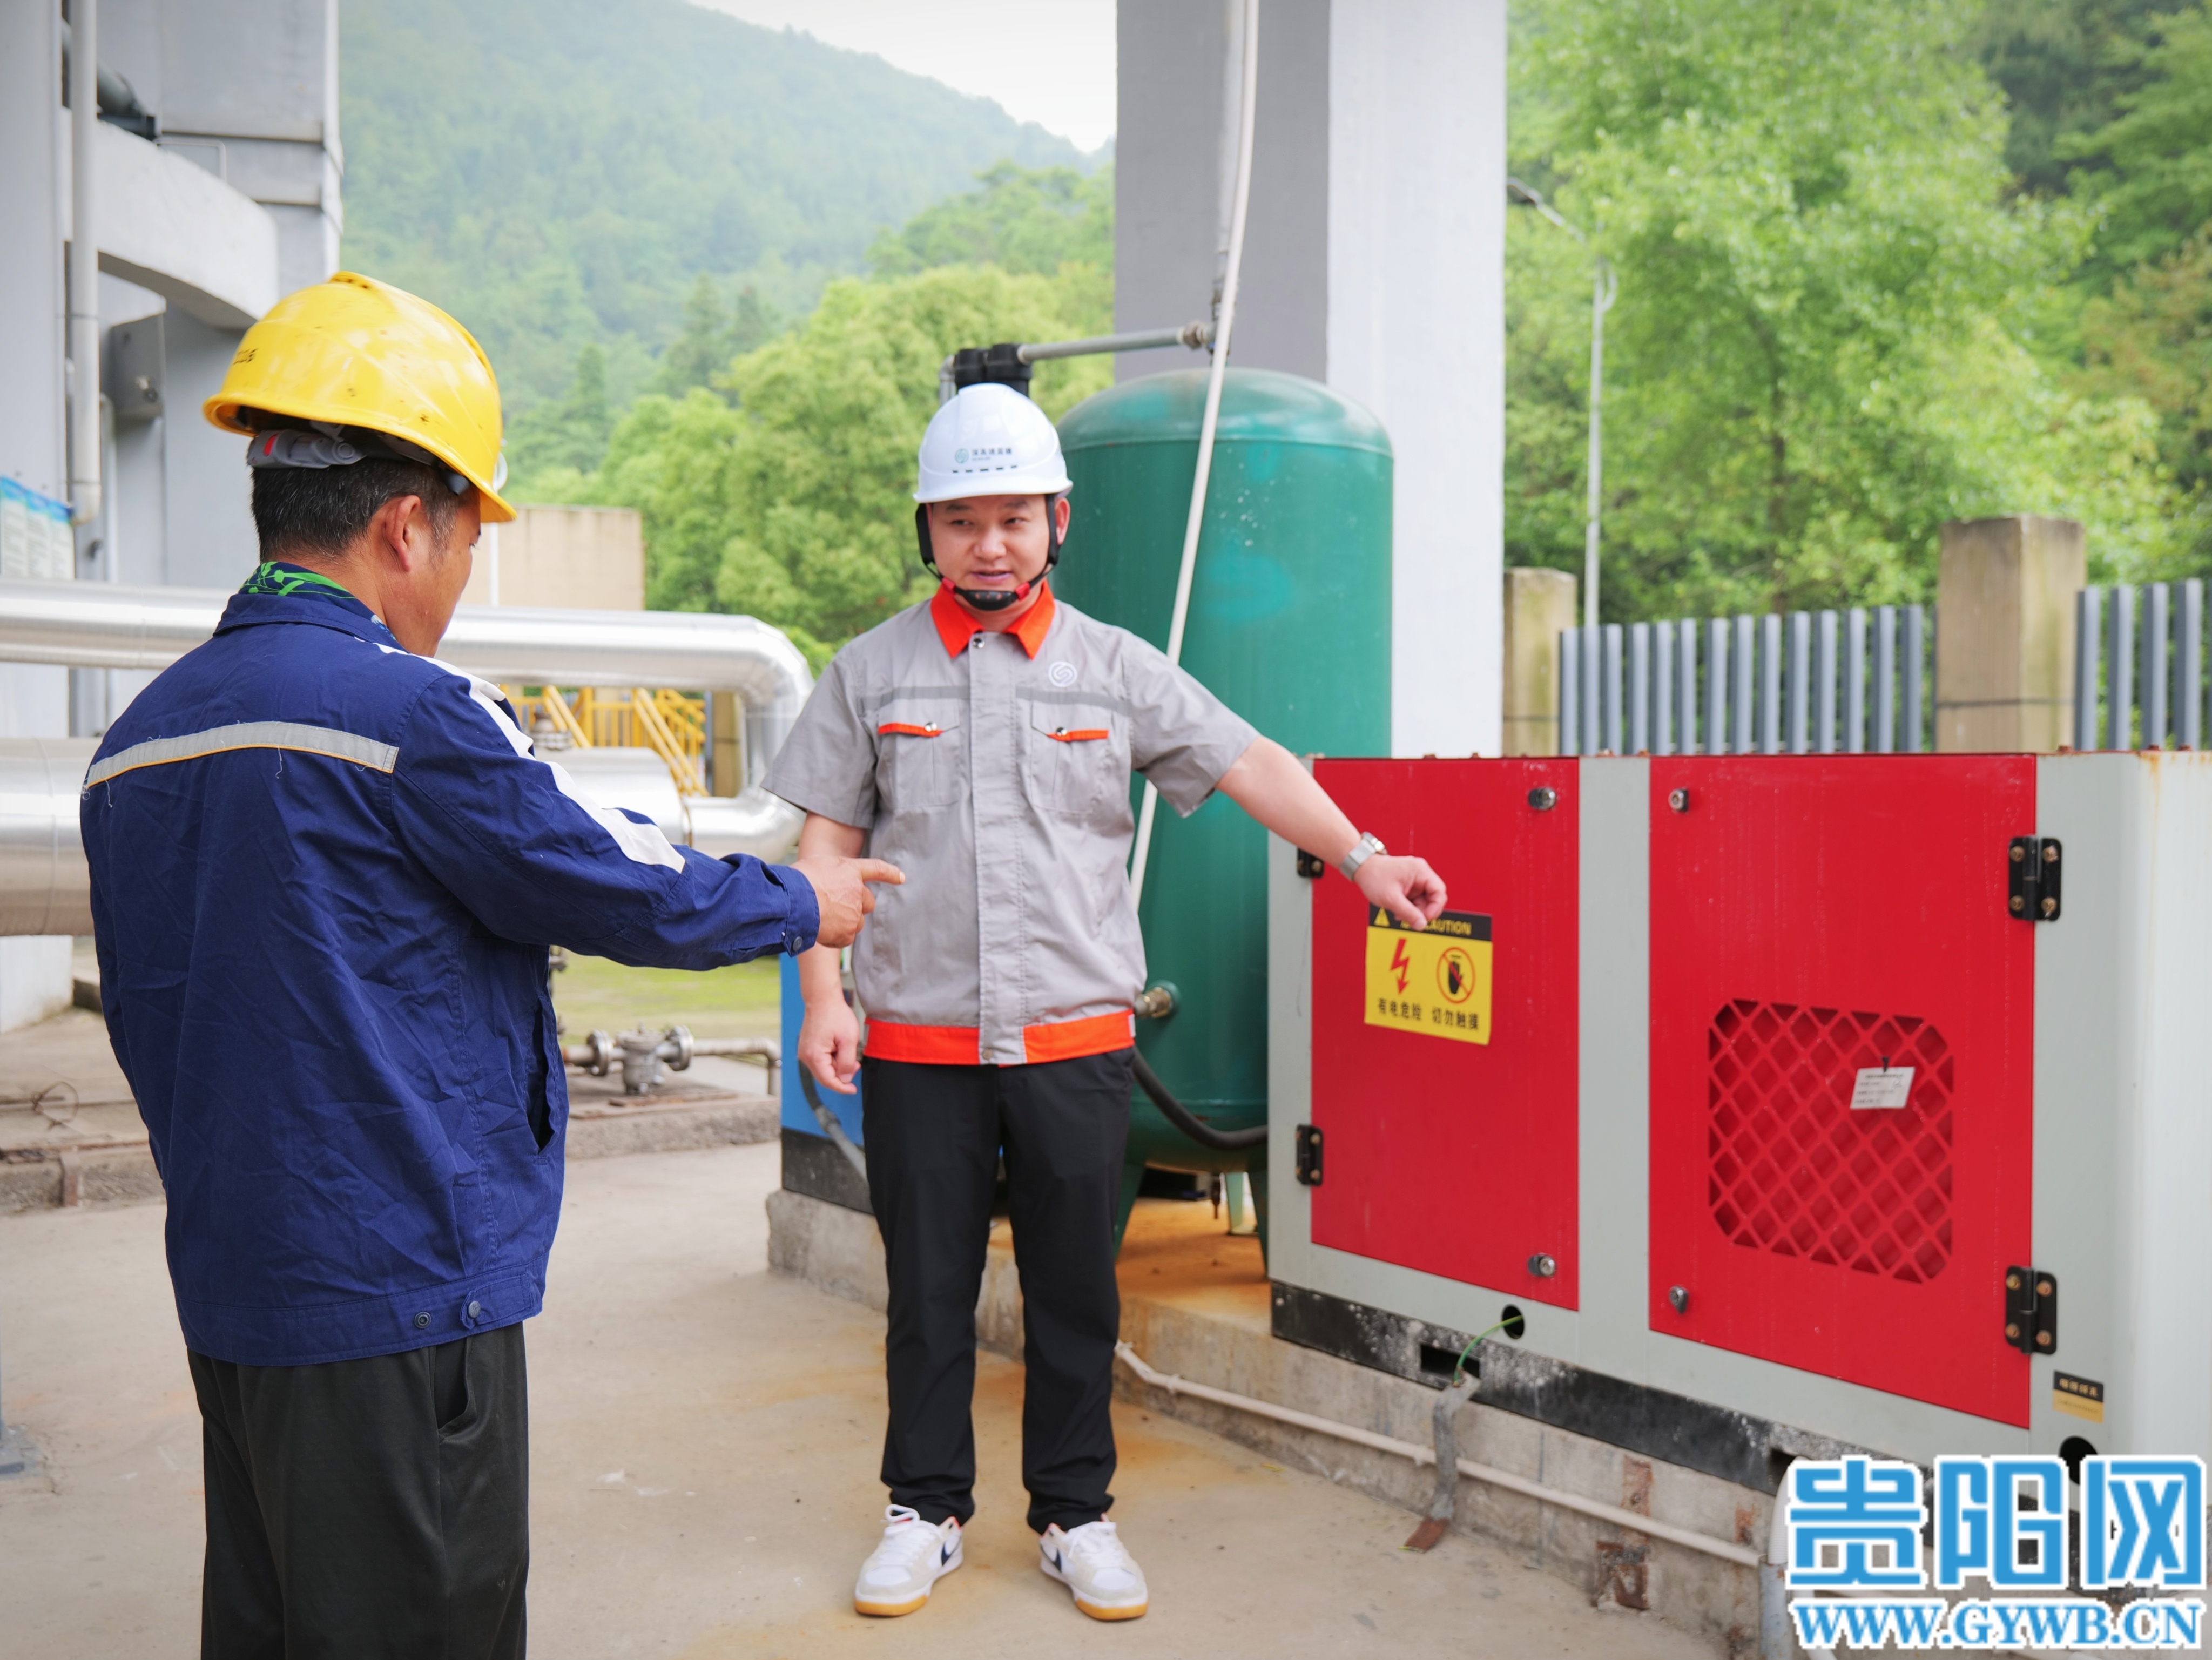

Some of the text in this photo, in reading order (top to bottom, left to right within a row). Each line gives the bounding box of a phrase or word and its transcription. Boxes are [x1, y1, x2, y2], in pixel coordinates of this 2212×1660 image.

[1379, 998, 1478, 1030] 有电危险 切勿触摸
